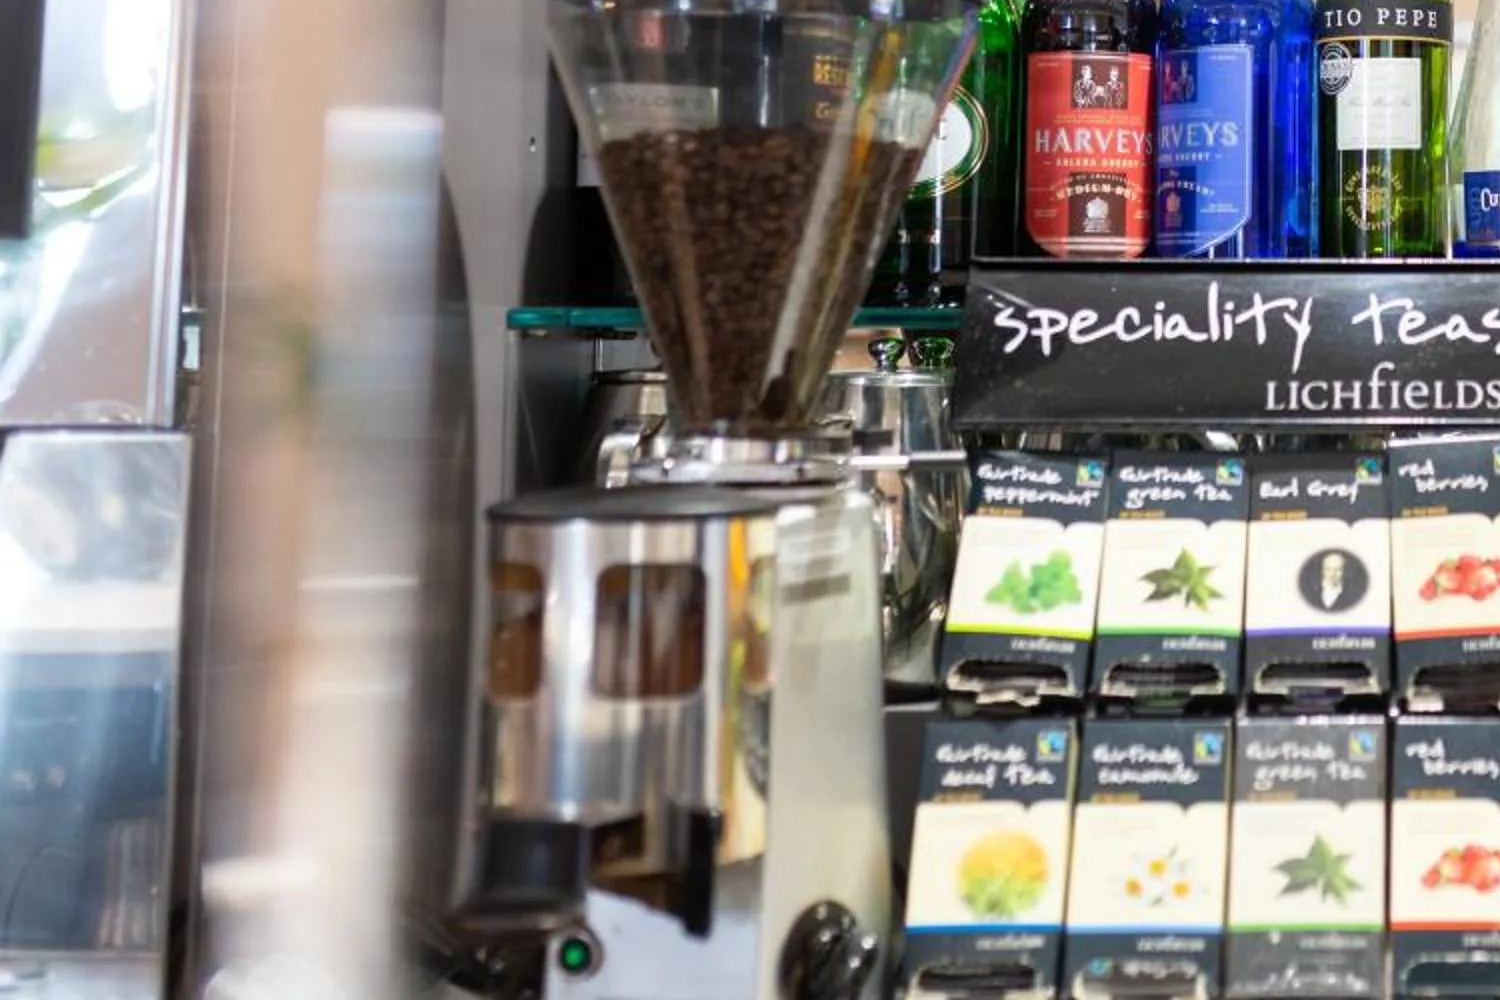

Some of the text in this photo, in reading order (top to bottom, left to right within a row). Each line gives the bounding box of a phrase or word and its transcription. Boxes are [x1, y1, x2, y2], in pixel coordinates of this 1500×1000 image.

[1324, 7, 1437, 28] TIO PEPE
[1035, 127, 1152, 154] HARVEYS
[1160, 121, 1239, 147] RVEYS
[993, 280, 1314, 374] speciality
[1398, 459, 1435, 478] red
[1259, 477, 1360, 505] Earl Grey
[1414, 473, 1488, 493] berries
[1405, 738, 1445, 758] red
